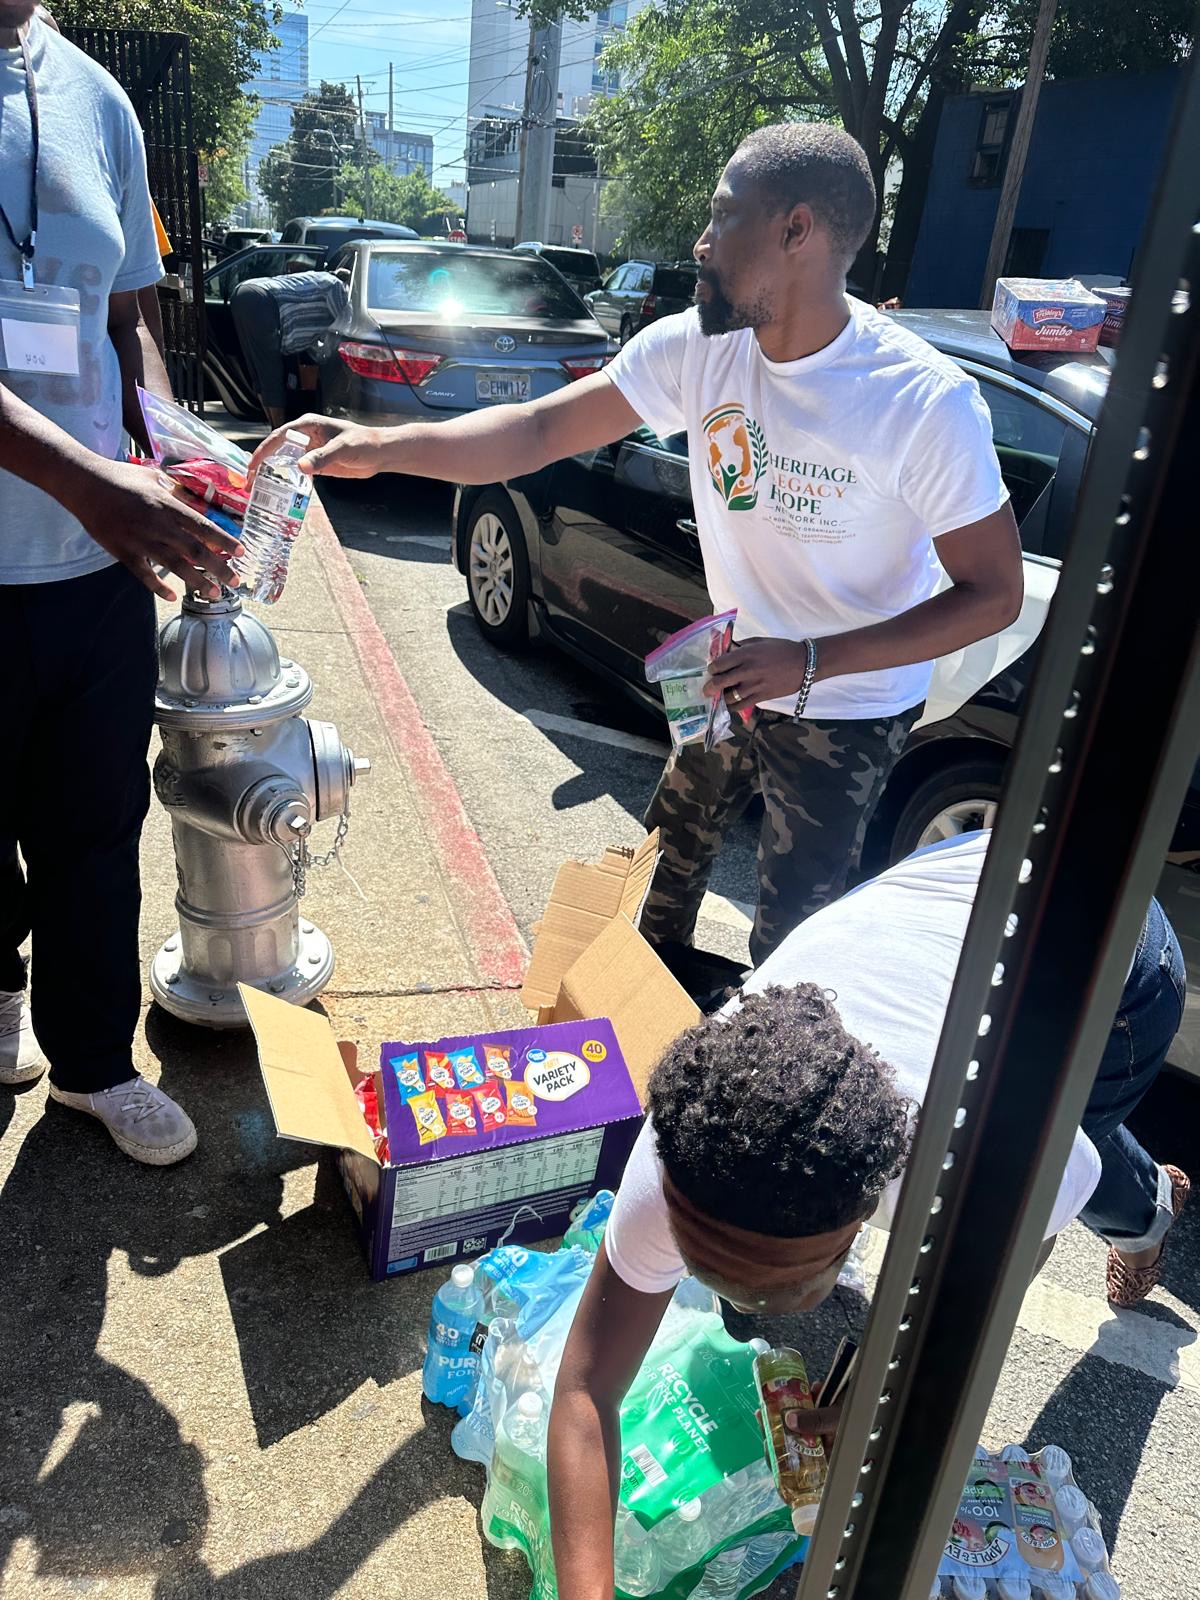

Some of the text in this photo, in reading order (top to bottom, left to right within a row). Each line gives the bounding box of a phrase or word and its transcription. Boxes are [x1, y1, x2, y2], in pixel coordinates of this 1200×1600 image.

[1035, 325, 1073, 337] Jumbo
[425, 390, 456, 398] CAMRY
[490, 380, 528, 396] EHW112
[770, 452, 857, 484] HERITAGE
[772, 471, 847, 498] EGACY
[770, 483, 822, 515] HOPE
[586, 1043, 603, 1054] 40
[533, 1061, 577, 1086] VARIETY
[546, 1074, 575, 1093] PACK
[436, 1323, 460, 1340] 40
[656, 1362, 719, 1436] RECYCLE
[671, 1405, 712, 1454] PLANET
[960, 1505, 1000, 1518] 100%
[944, 1543, 961, 1560] EV
[971, 1539, 1004, 1565] APPLE
